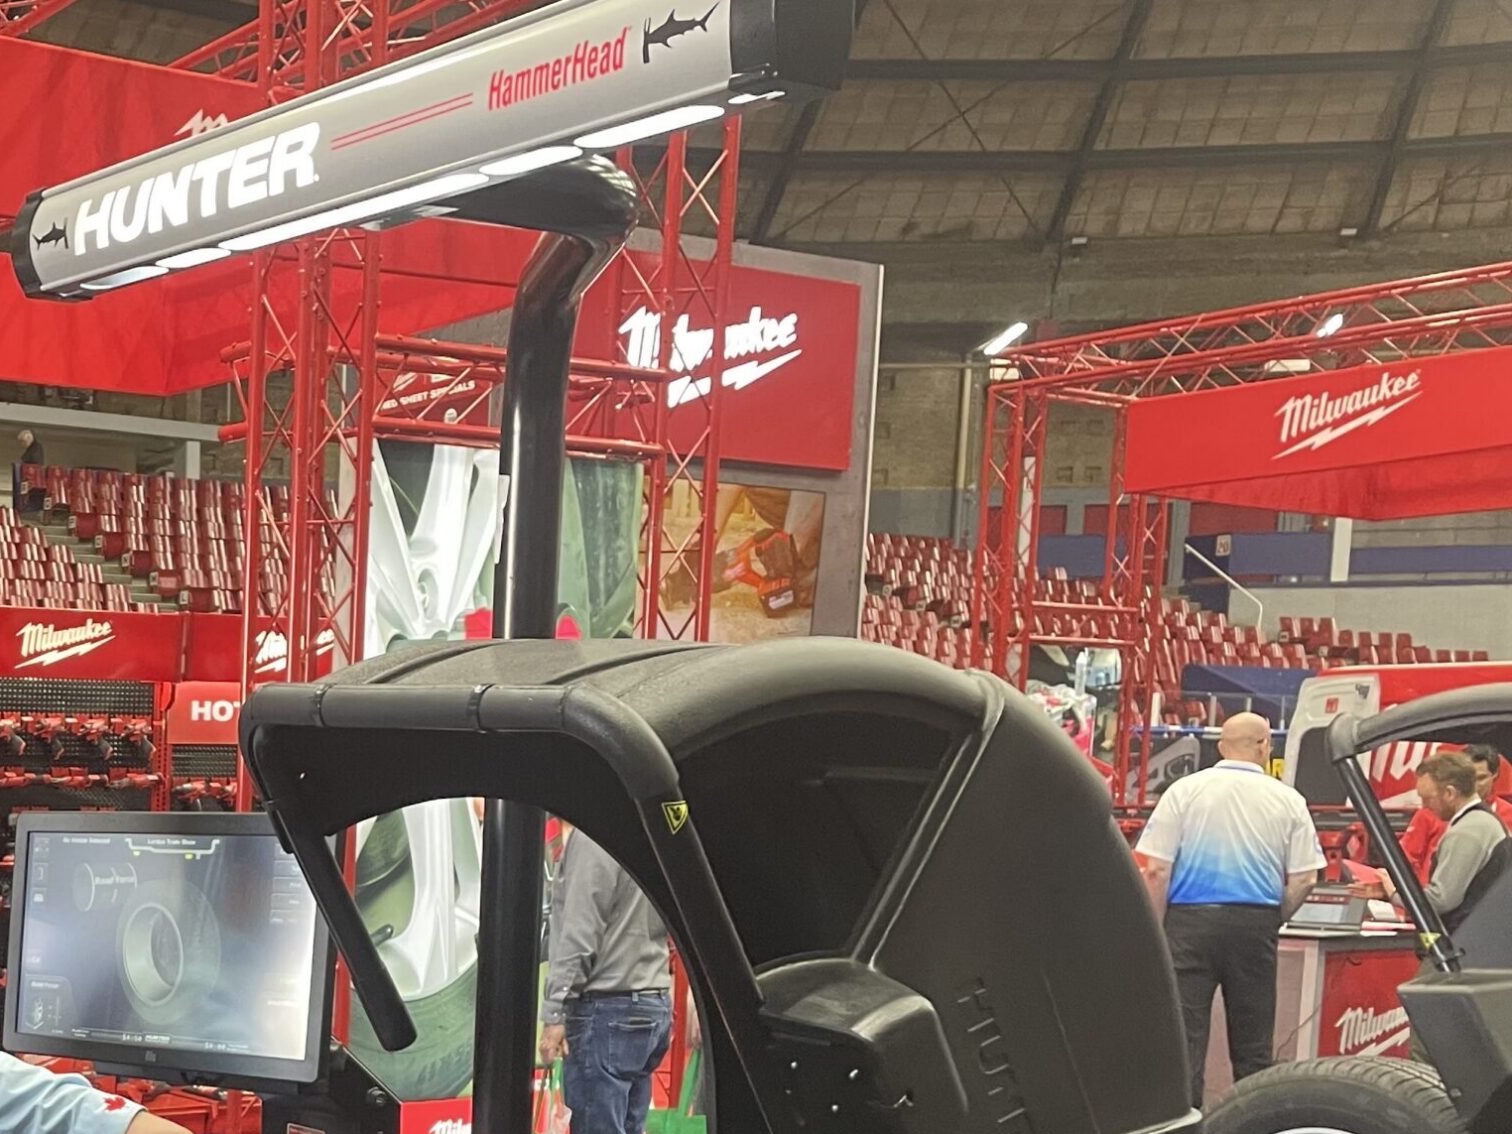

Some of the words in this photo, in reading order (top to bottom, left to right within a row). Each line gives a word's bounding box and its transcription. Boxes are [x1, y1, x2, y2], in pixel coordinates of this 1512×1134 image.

[489, 26, 628, 110] HammerHead
[74, 122, 320, 256] HUNTER
[1274, 371, 1421, 443] Milwaukee
[16, 618, 112, 656] Milwaukee
[191, 700, 239, 721] HO
